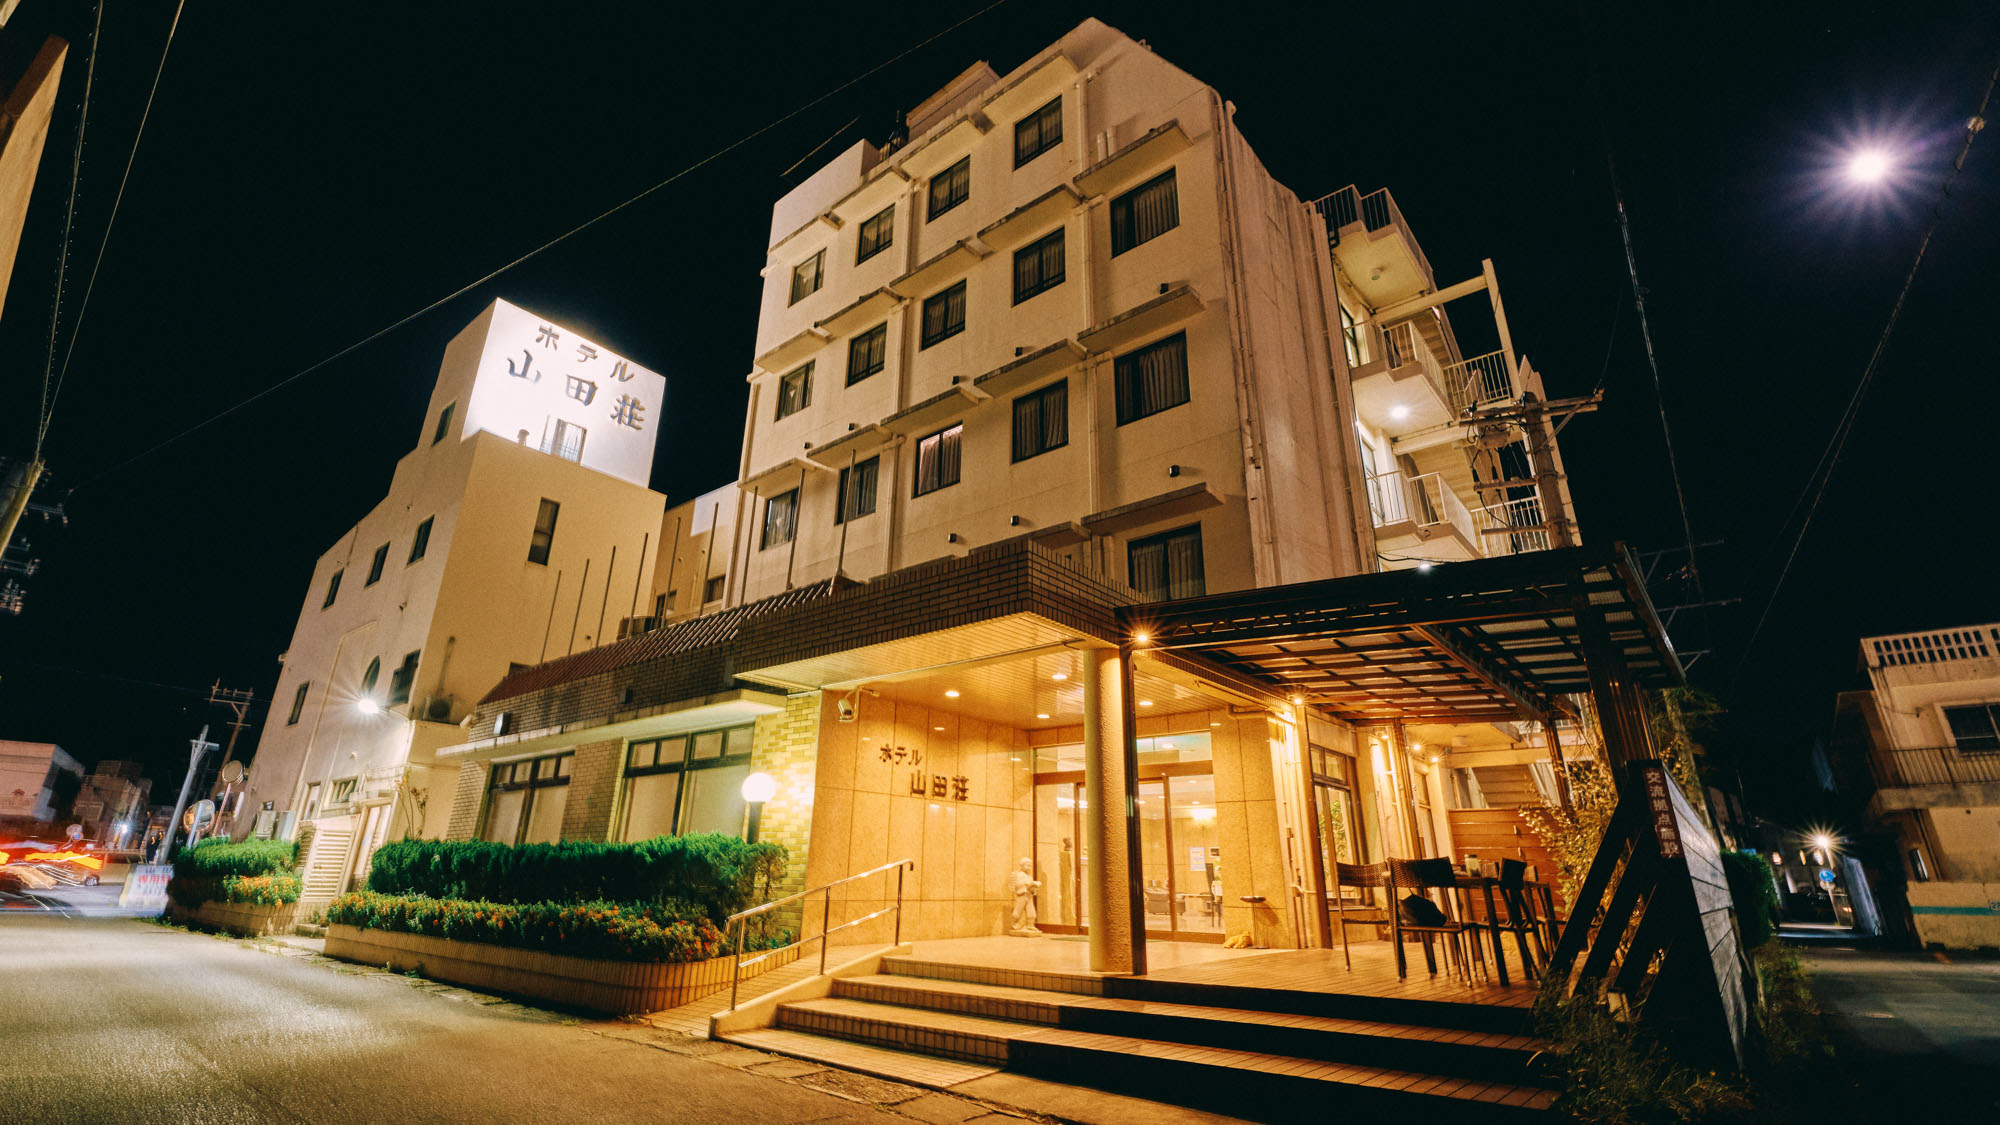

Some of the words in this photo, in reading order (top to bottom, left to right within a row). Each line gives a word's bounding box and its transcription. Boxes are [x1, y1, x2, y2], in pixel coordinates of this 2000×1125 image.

[536, 325, 635, 382] ホテル
[507, 349, 645, 431] 山田荘
[879, 743, 922, 766] ホテル
[910, 769, 970, 801] 山田荘
